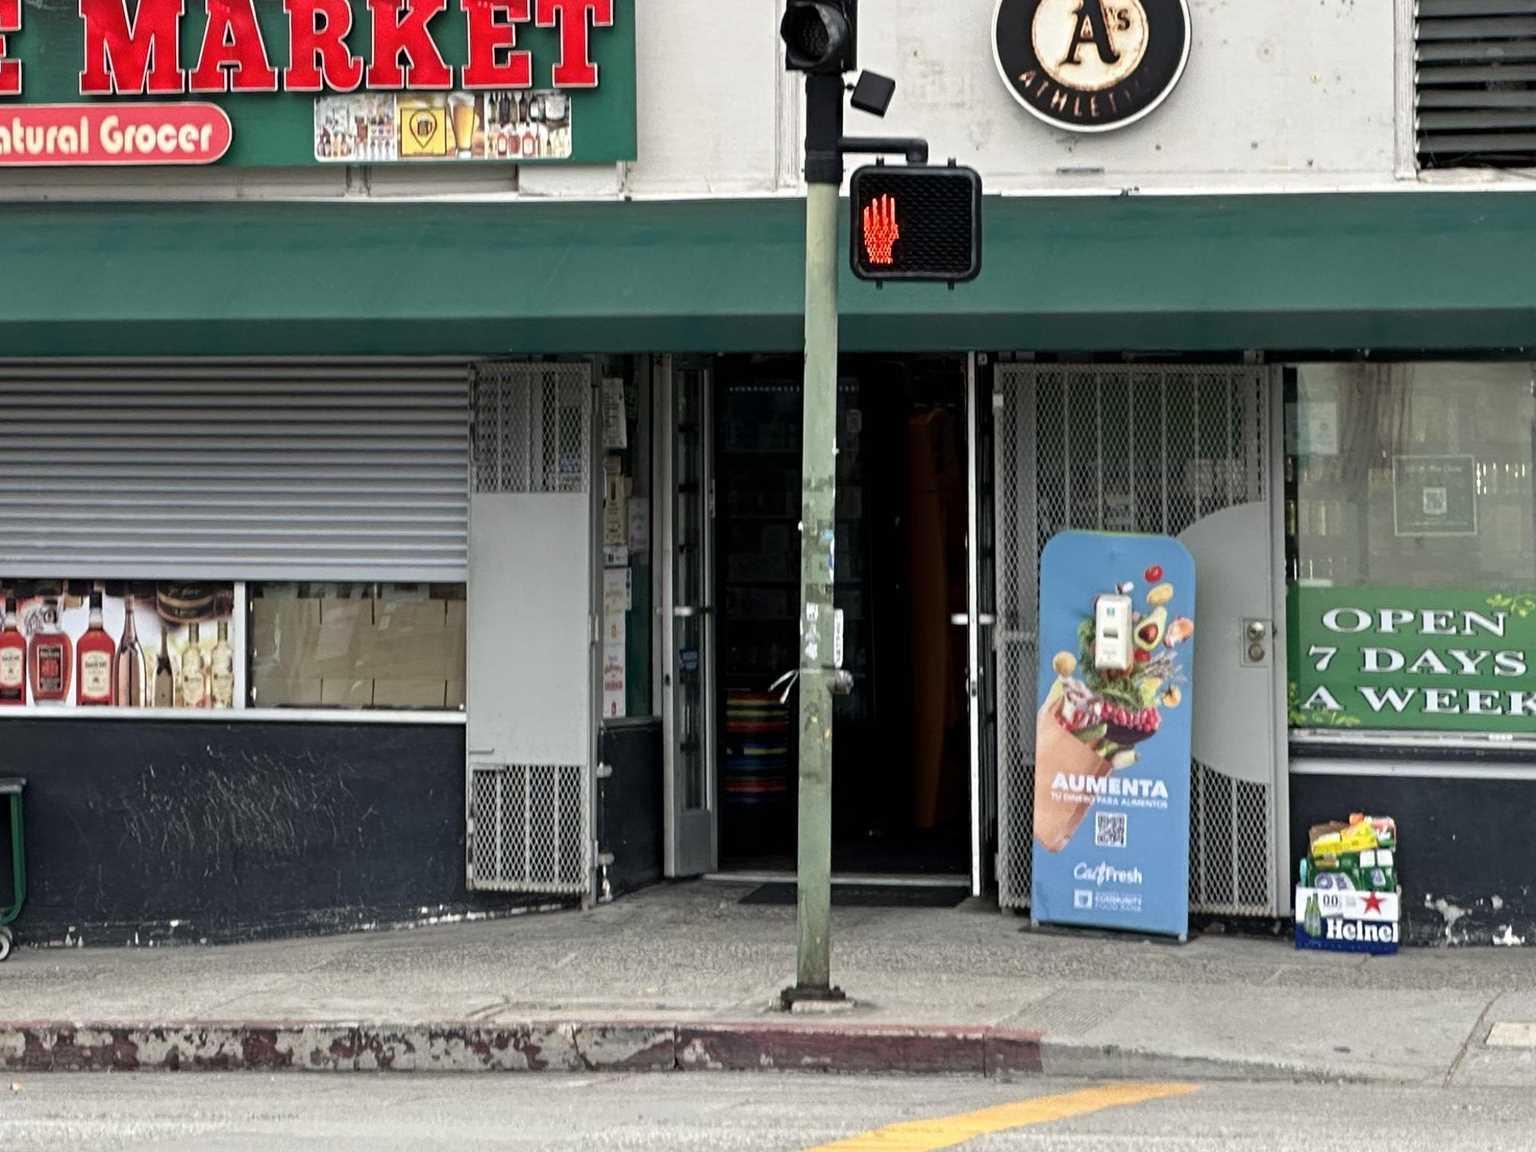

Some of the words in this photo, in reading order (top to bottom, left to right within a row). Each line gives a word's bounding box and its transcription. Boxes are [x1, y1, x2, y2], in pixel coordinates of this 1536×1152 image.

[100, 115, 212, 154] Grocer
[1322, 607, 1505, 638] OPEN
[1309, 645, 1337, 672] 7
[1359, 647, 1527, 677] DAYS
[1300, 685, 1344, 711] A
[1359, 686, 1536, 716] WEEK
[1051, 773, 1168, 798] AUMENTA
